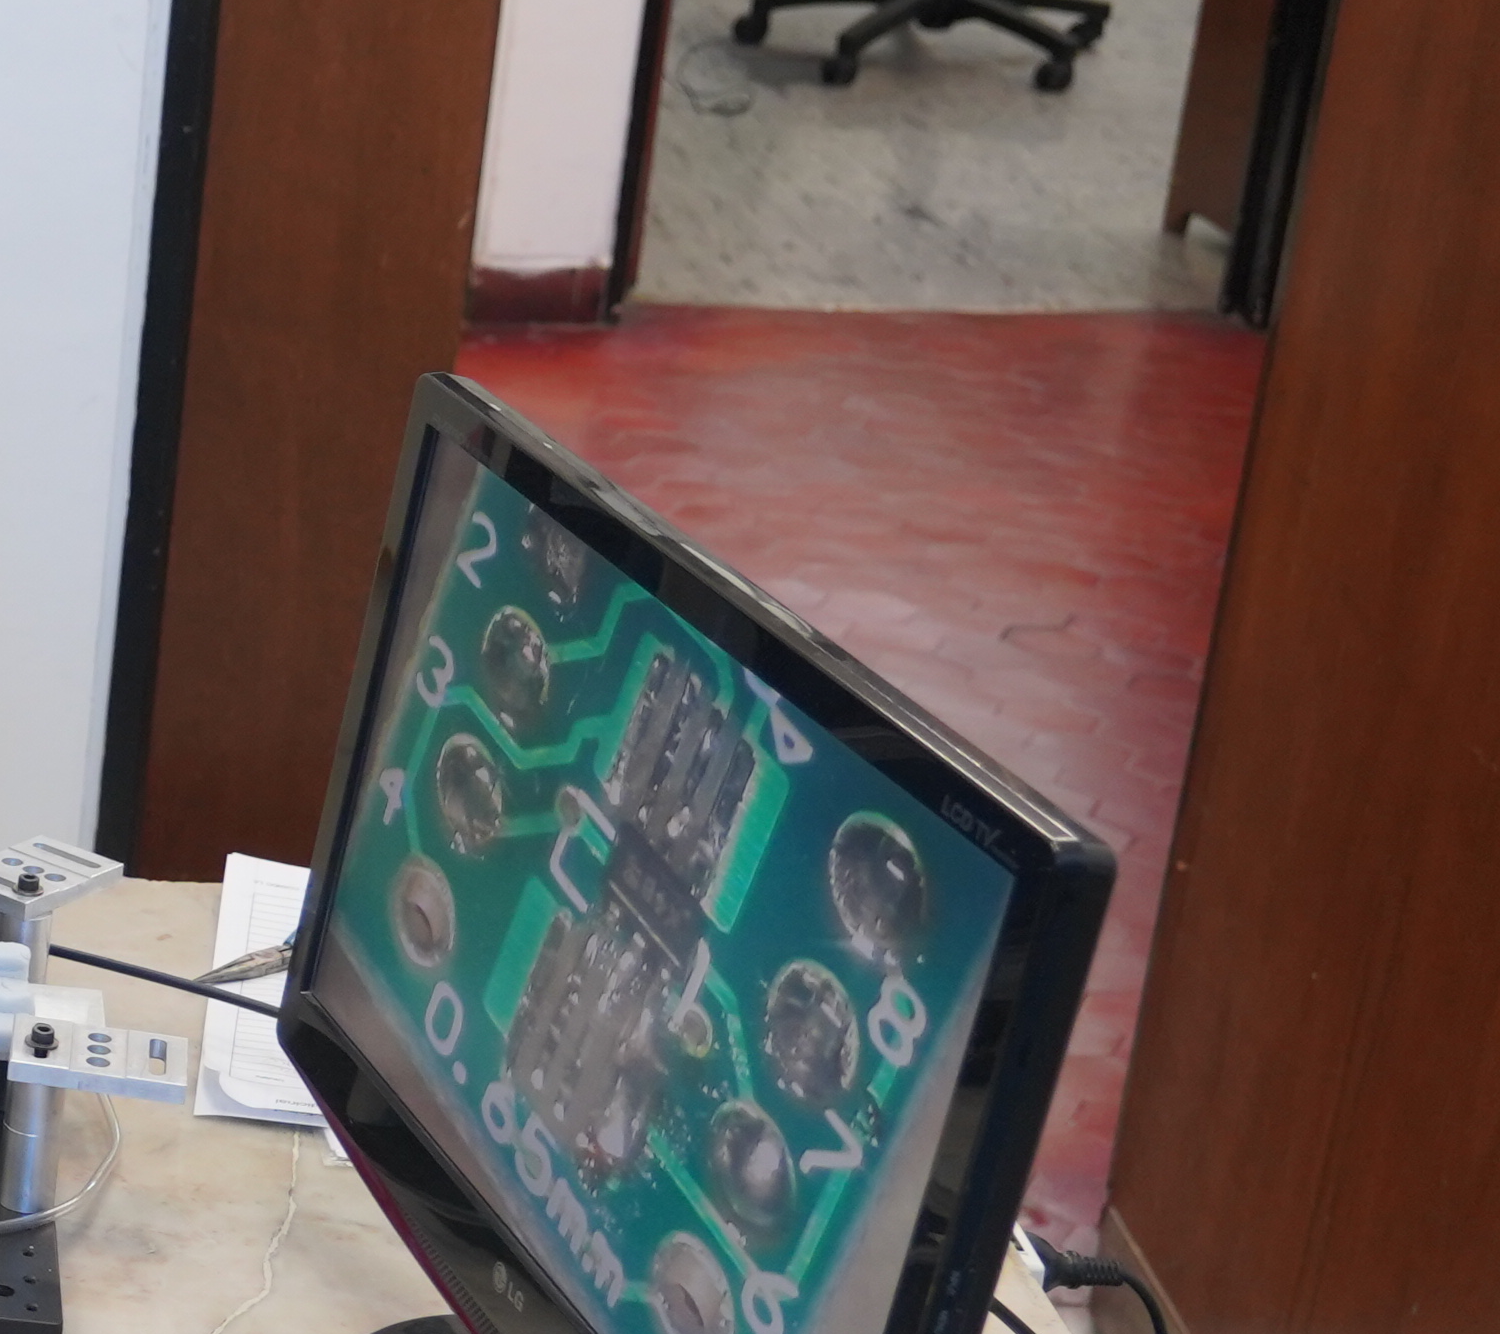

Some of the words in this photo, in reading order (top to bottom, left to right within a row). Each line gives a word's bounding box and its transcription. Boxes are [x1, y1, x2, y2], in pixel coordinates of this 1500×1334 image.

[456, 511, 498, 588] 2
[416, 633, 459, 709] 3
[866, 973, 928, 1068] 8
[797, 1107, 864, 1178] 7
[506, 1282, 527, 1314] LG
